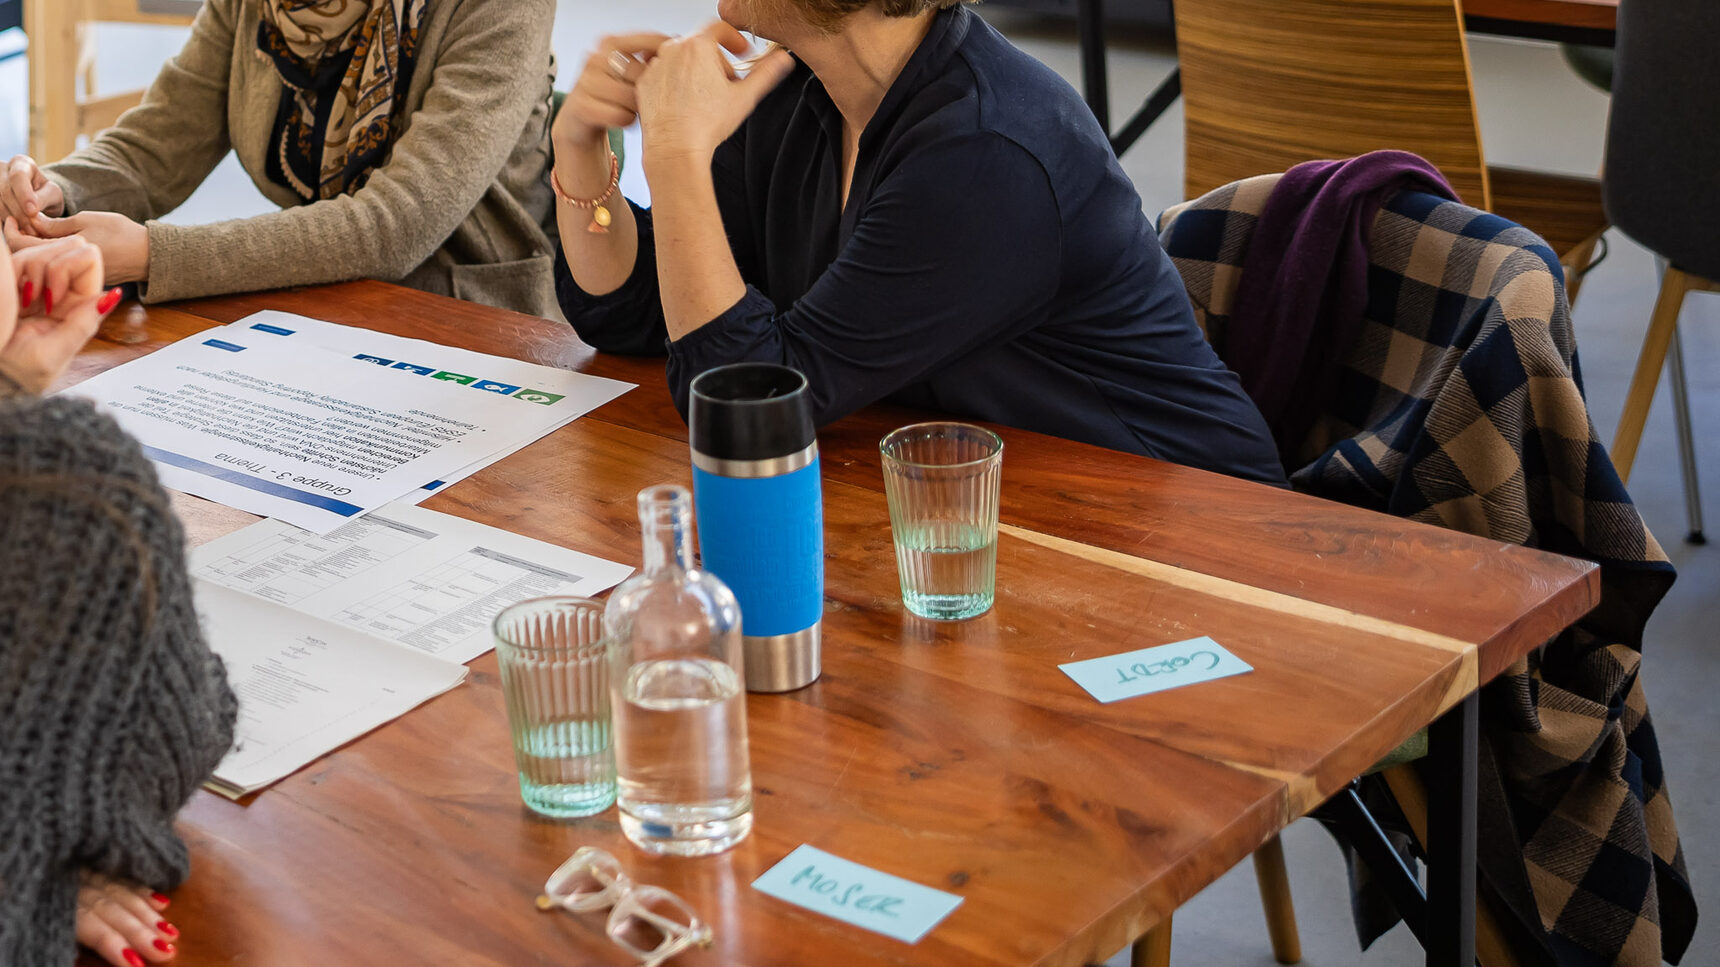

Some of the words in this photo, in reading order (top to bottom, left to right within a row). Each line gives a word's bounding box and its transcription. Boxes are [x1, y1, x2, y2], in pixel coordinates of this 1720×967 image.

[326, 417, 370, 429] werden?
[302, 432, 358, 450] mitgedacht
[357, 431, 431, 454] Mitarbeitenden
[371, 427, 442, 448] mitgenommen
[299, 439, 397, 469] Unternehmens-DNA
[301, 449, 340, 462] Schritte
[343, 435, 421, 460] Kommunikation
[357, 447, 409, 464] Bereichen
[214, 453, 267, 473] Thema
[311, 460, 338, 469] neue
[340, 459, 387, 474] nächsten
[276, 472, 292, 480] 3
[338, 467, 375, 480] Unsere
[292, 476, 352, 496] Gruppe
